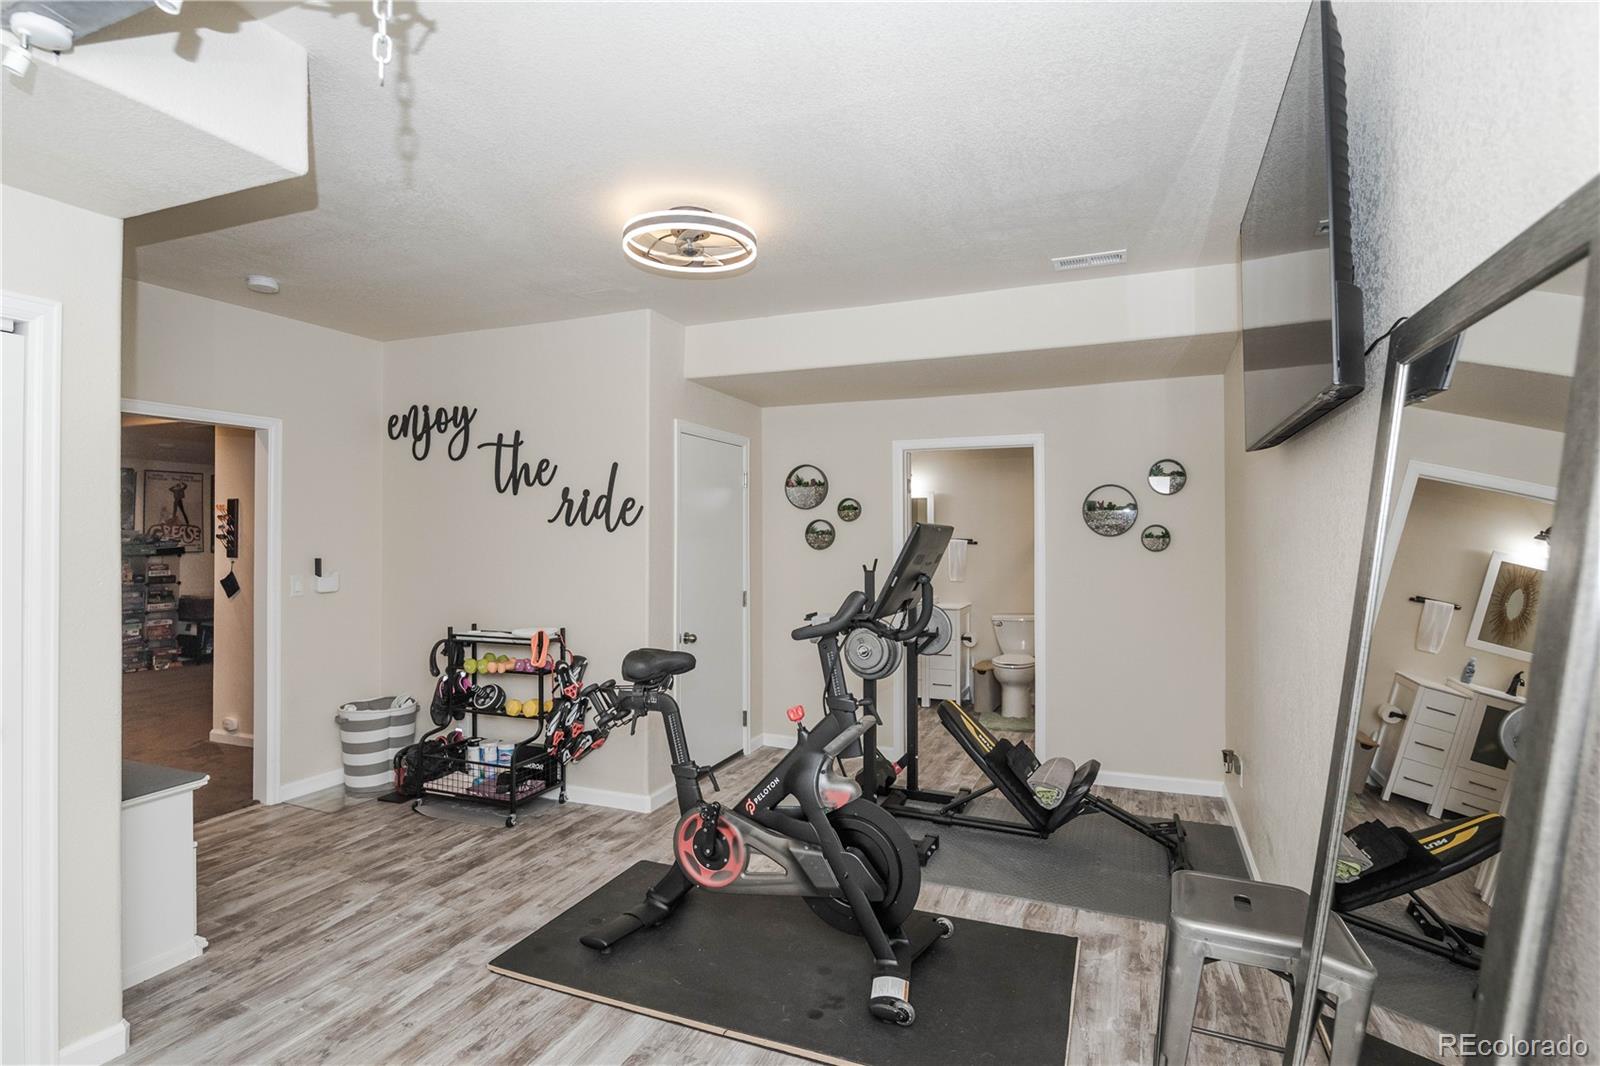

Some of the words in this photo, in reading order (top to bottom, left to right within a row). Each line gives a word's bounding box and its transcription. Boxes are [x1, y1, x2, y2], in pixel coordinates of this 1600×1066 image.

[388, 404, 478, 461] enjoy
[477, 430, 558, 496] the
[547, 462, 644, 533] ride
[147, 524, 201, 543] GREASE
[754, 776, 780, 804] PELOTON
